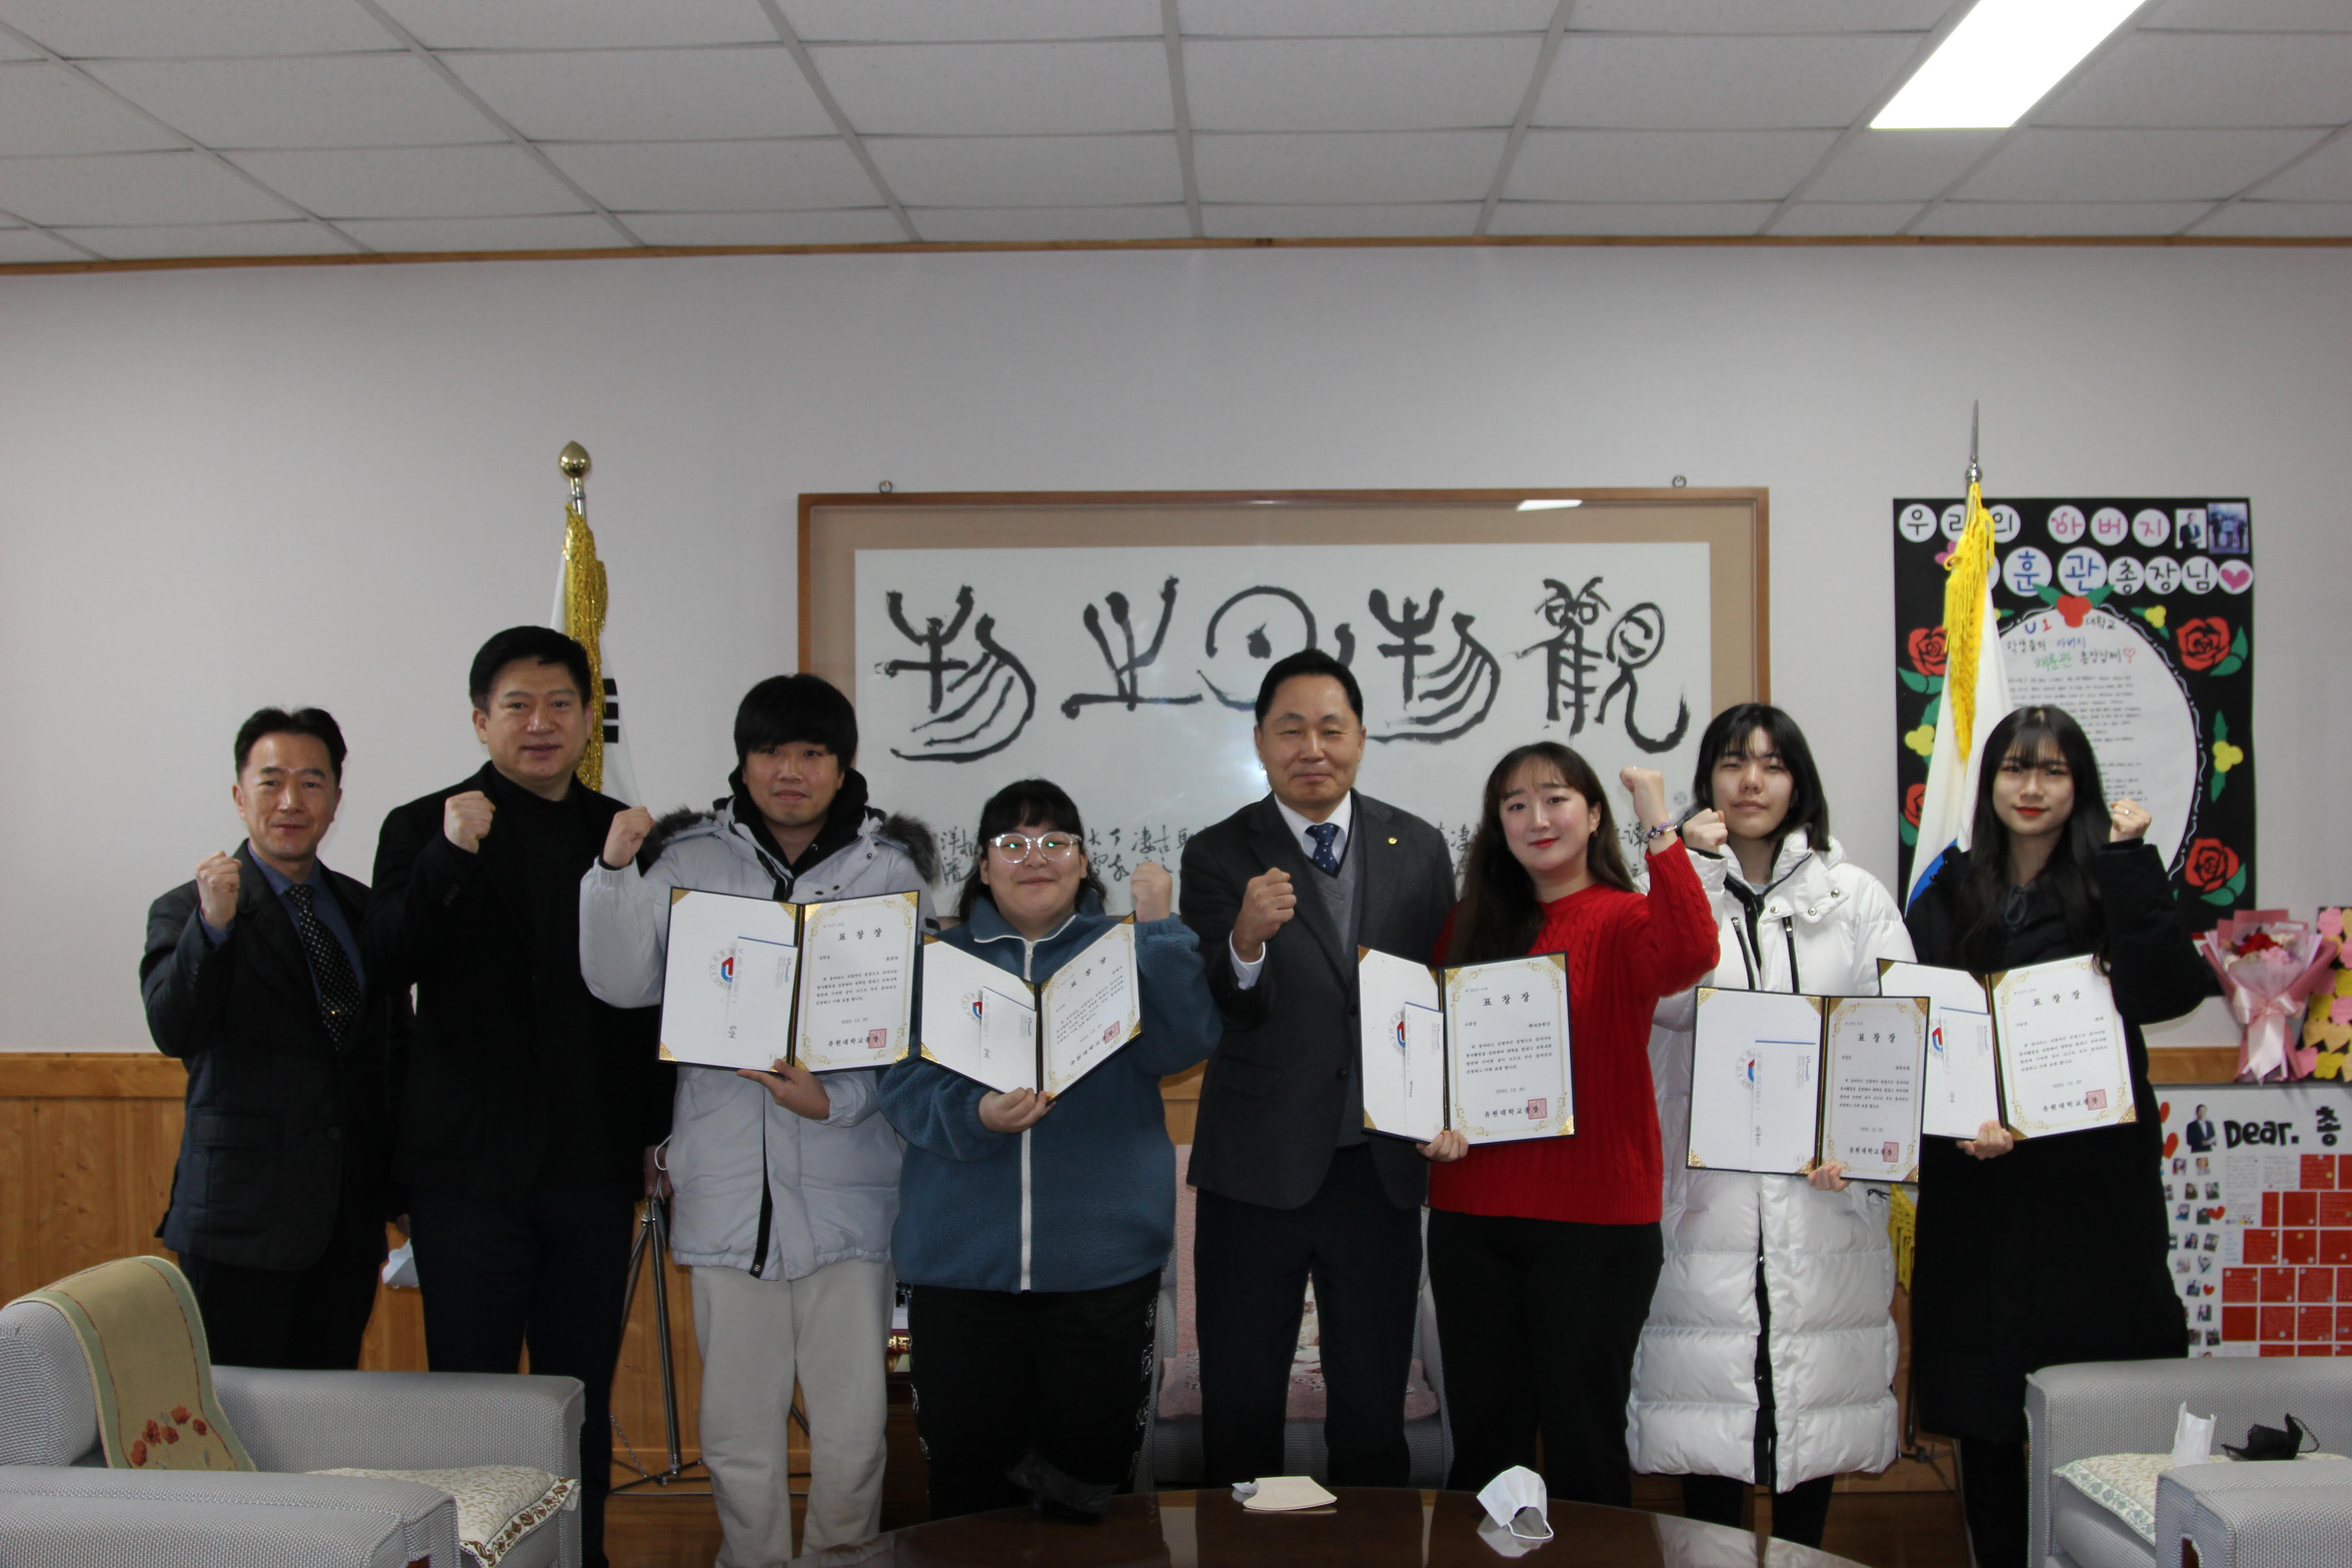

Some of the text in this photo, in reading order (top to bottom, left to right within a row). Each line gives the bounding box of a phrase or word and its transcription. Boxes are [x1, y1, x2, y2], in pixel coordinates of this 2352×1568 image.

[2014, 550, 2211, 594] 훈관 총장님
[2086, 615, 2117, 630] 대학교
[2007, 637, 2086, 653] 학생들의 아버지
[2081, 648, 2122, 665] 총장님께
[838, 928, 882, 941] 표창장
[1483, 992, 1530, 1006] 표창장
[1858, 1033, 1896, 1043] 표창장
[2223, 1106, 2342, 1149] Dear. 총
